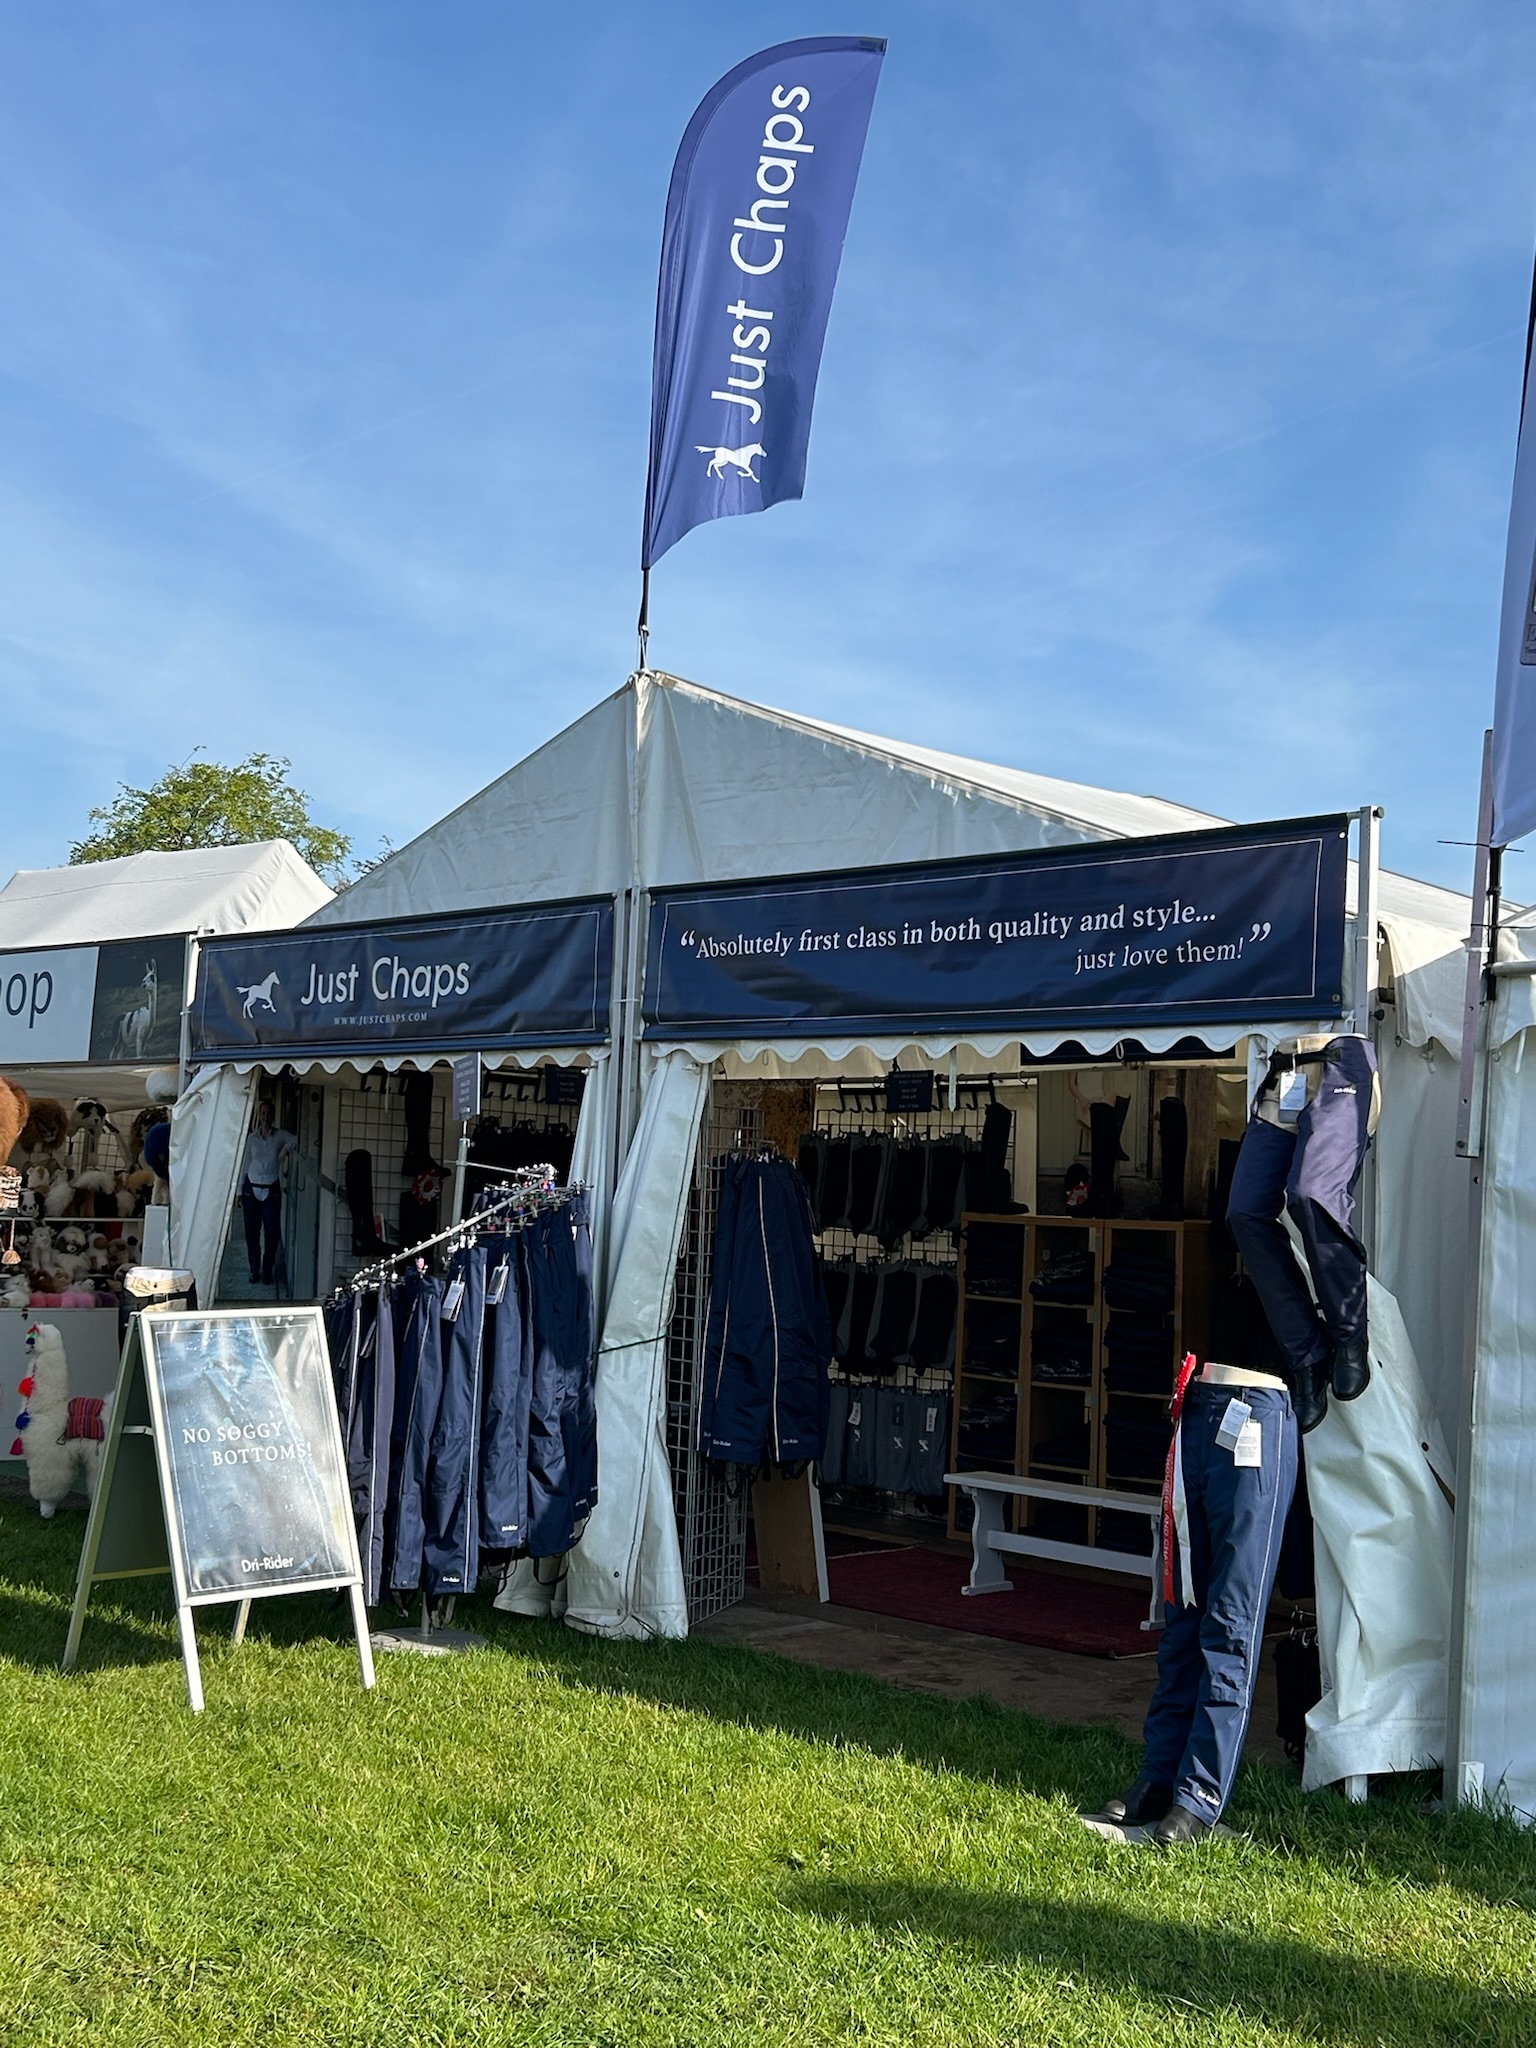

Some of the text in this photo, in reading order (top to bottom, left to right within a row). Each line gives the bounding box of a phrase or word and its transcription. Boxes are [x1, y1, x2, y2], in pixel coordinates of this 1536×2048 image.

[711, 84, 814, 425] Just Chaps
[798, 929, 841, 952] first
[846, 926, 897, 949] class
[902, 922, 924, 945] in
[930, 917, 982, 943] both
[988, 911, 1074, 944] quality
[1079, 903, 1125, 932] and
[1074, 948, 1116, 975] just
[1122, 945, 1168, 967] love
[300, 955, 470, 1008] Just Chaps
[0, 971, 53, 1029] op
[333, 1012, 428, 1026] WWW.JUSTCHAPS.COM
[182, 1421, 283, 1444] NO SOGGY
[212, 1442, 313, 1466] BOTTOMS!
[241, 1554, 294, 1573] Dri-Rider
